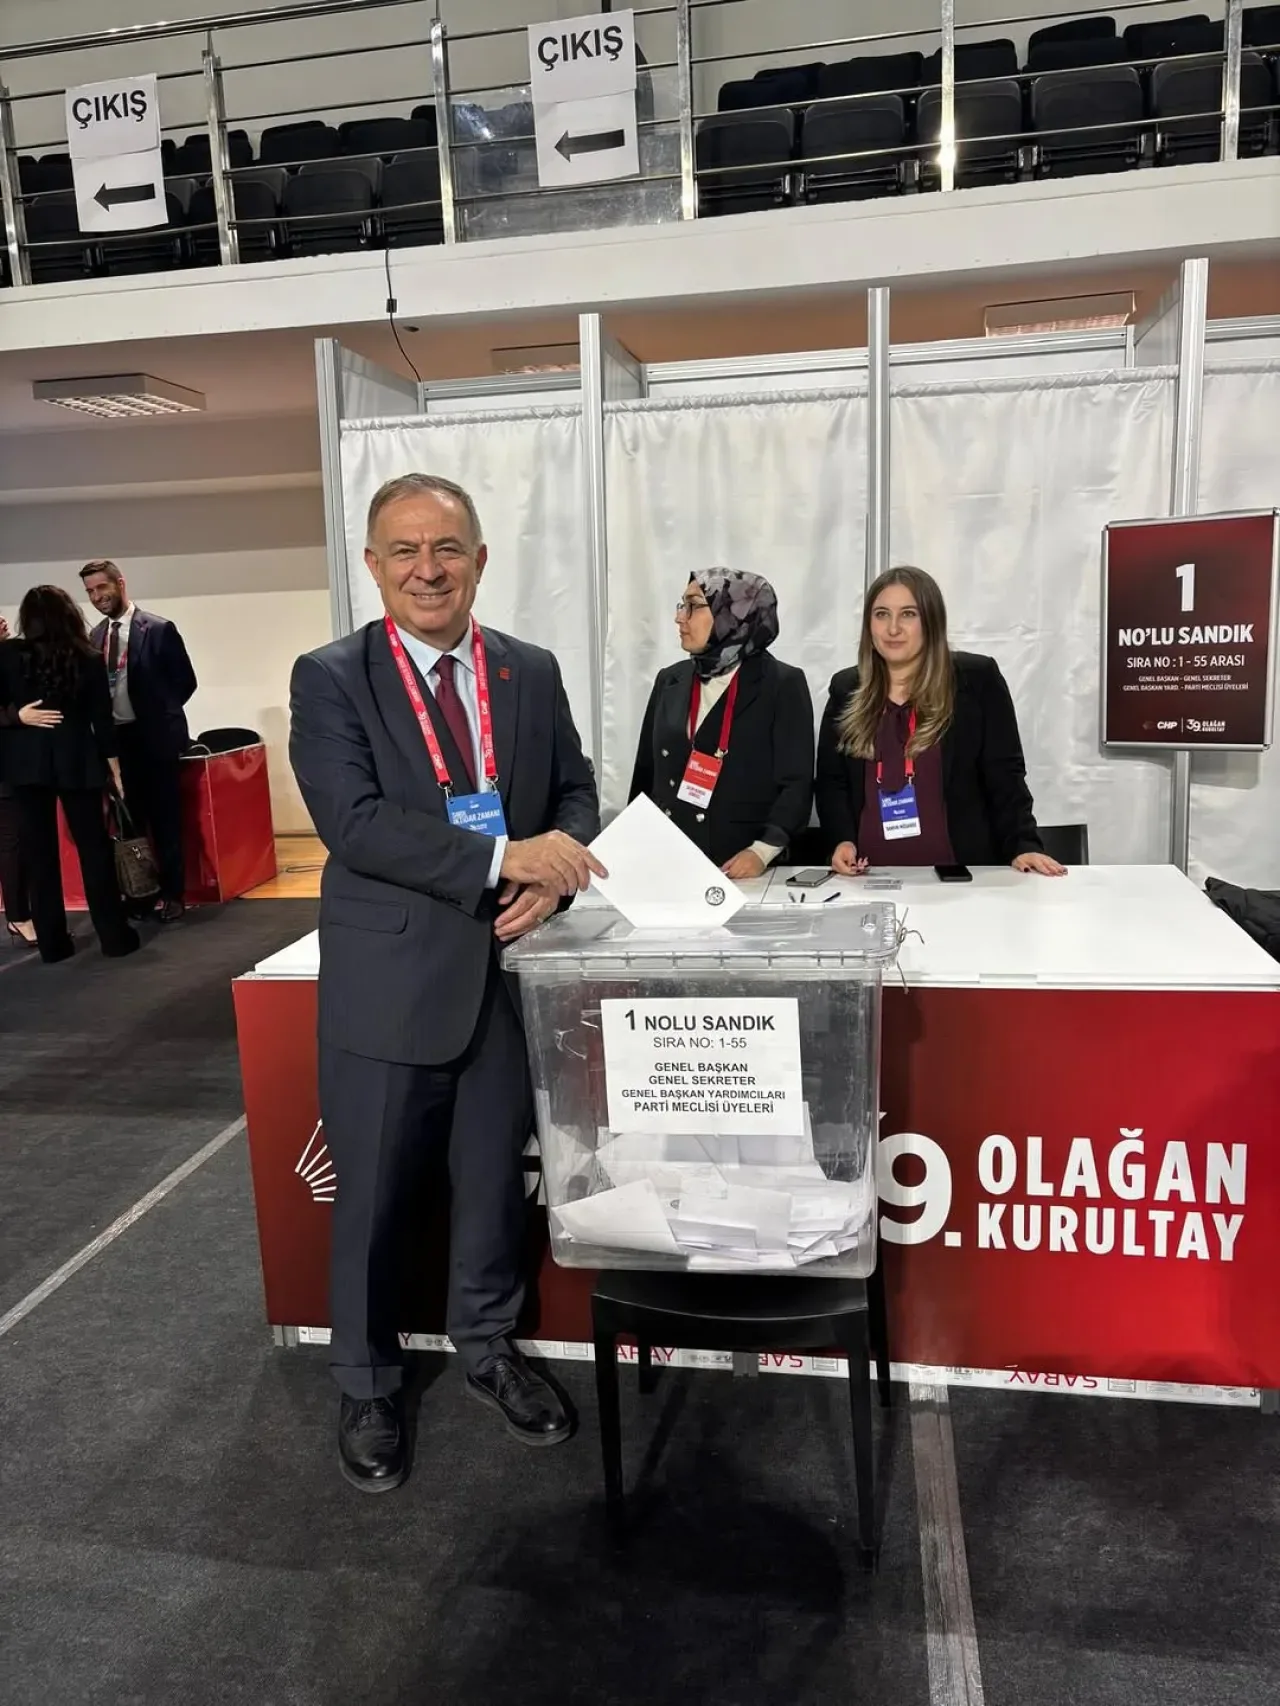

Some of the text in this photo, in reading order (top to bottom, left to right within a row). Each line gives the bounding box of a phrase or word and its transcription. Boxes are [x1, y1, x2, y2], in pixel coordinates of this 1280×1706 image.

[537, 25, 623, 72] ÇIKIŞ
[72, 89, 147, 129] ÇIKIŞ
[1175, 563, 1195, 612] 1
[1118, 624, 1254, 647] NO'LU SANDIK
[1126, 656, 1151, 668] SIRA
[1153, 656, 1170, 668] NO
[1194, 656, 1207, 667] 55
[1210, 654, 1245, 667] ARASI
[1157, 721, 1178, 729] CHP
[624, 1009, 775, 1031] 1 NOLU SANDIK
[653, 1037, 747, 1048] SIRA NO: 1-55
[654, 1062, 748, 1074] GENEL BAŞKAN
[648, 1075, 756, 1086] GENEL SEKRETER
[621, 1089, 786, 1100] GENEL BAŞKAN YARDIMCILARI
[634, 1101, 774, 1114] PARTİ MECLİSİ ÜYELERİ
[877, 1127, 1248, 1247] 9. OLAĞAN
[978, 1202, 1244, 1262] KURULTAY
